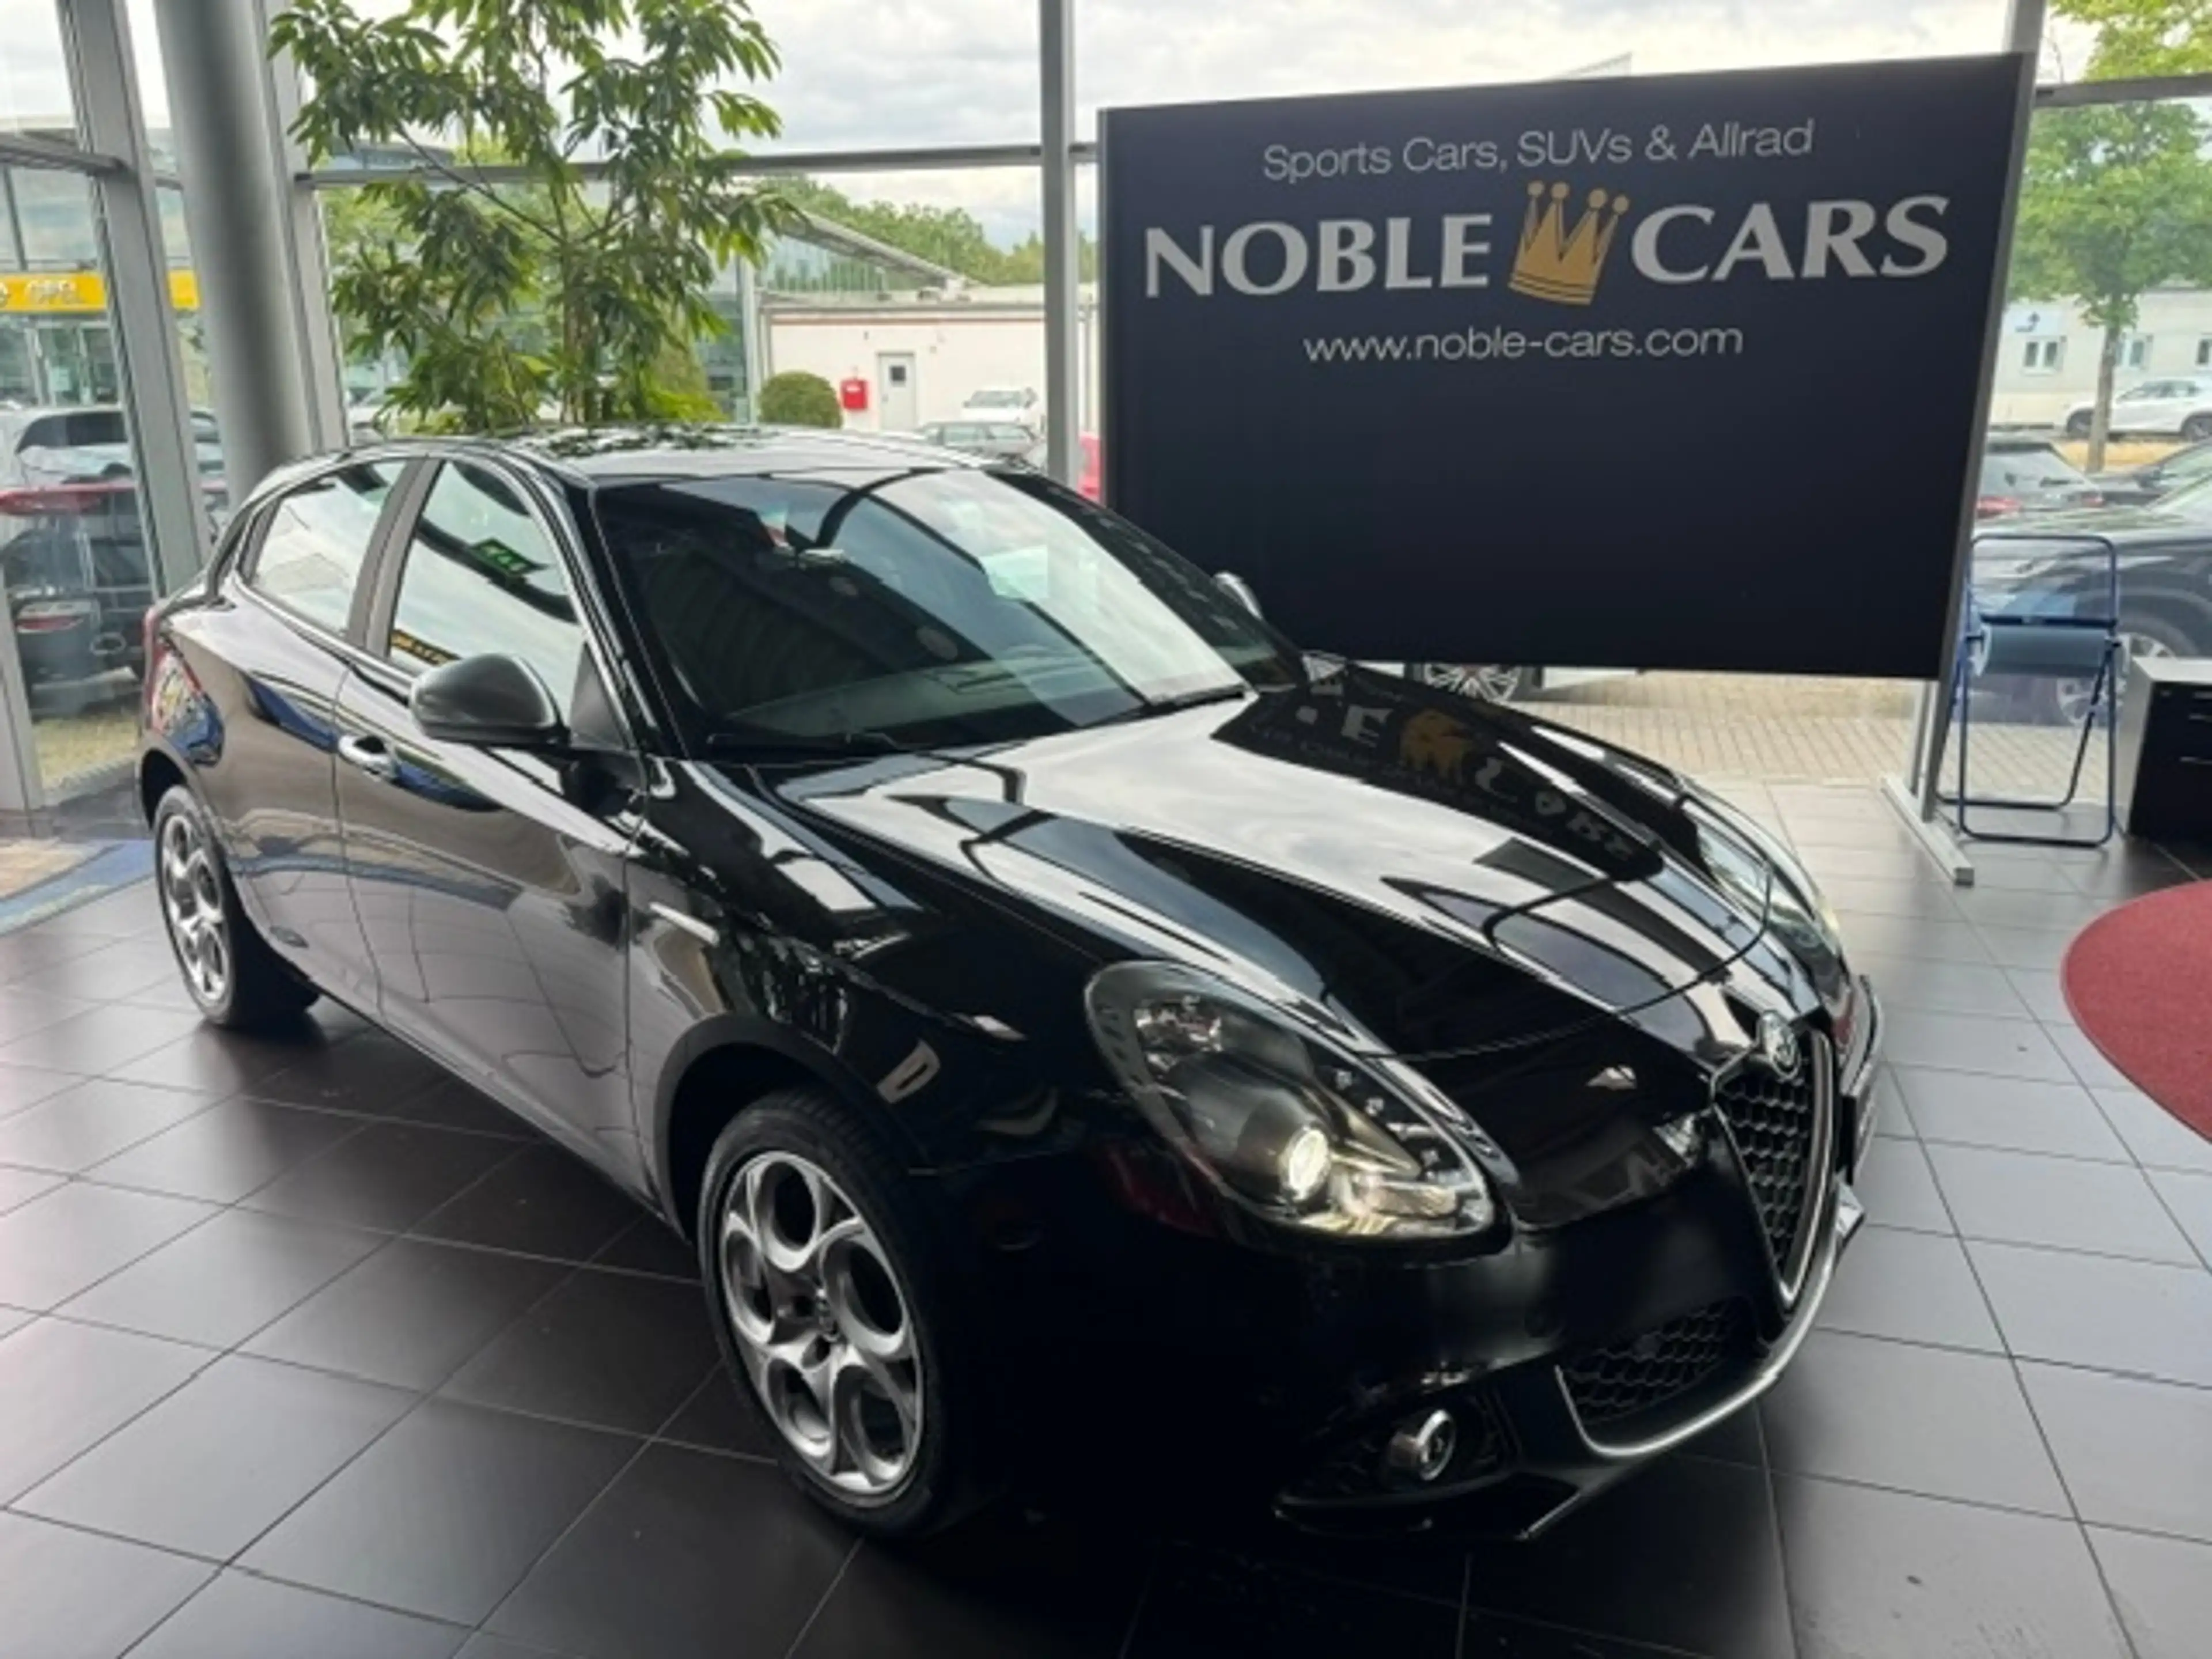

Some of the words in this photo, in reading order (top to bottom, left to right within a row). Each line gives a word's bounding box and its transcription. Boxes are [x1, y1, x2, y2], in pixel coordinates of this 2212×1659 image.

[1263, 144, 1392, 184] Sports
[1402, 136, 1508, 173] Cars,
[1517, 128, 1633, 168] SUVs
[1645, 124, 1677, 161] &
[1687, 118, 1815, 159] Allrad
[1145, 213, 1493, 298] NOBLE
[1632, 195, 1949, 283] CARS
[1302, 325, 1744, 362] www.noble-cars.com
